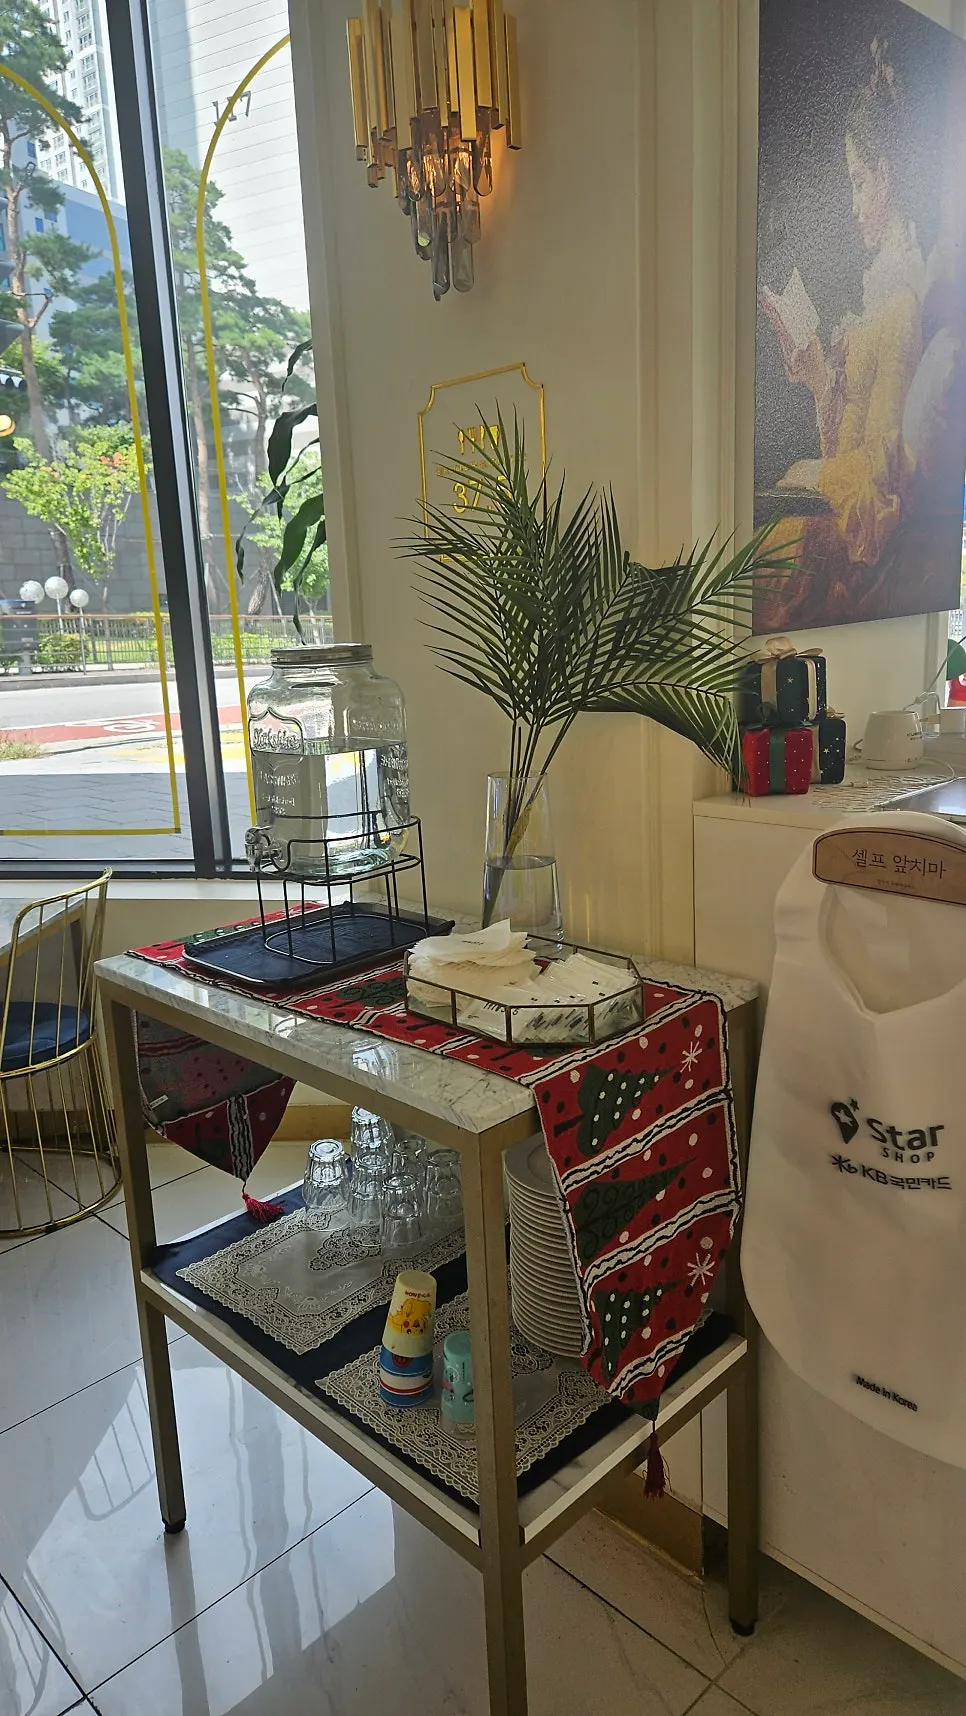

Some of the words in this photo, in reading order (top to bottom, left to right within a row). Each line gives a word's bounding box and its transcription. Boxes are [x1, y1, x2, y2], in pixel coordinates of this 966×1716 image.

[851, 849, 887, 869] 셀프
[893, 854, 948, 879] 앞치마
[866, 1117, 945, 1152] Star
[881, 1147, 936, 1164] SHOP
[856, 1375, 881, 1395] Made
[892, 1391, 919, 1412] Korea
